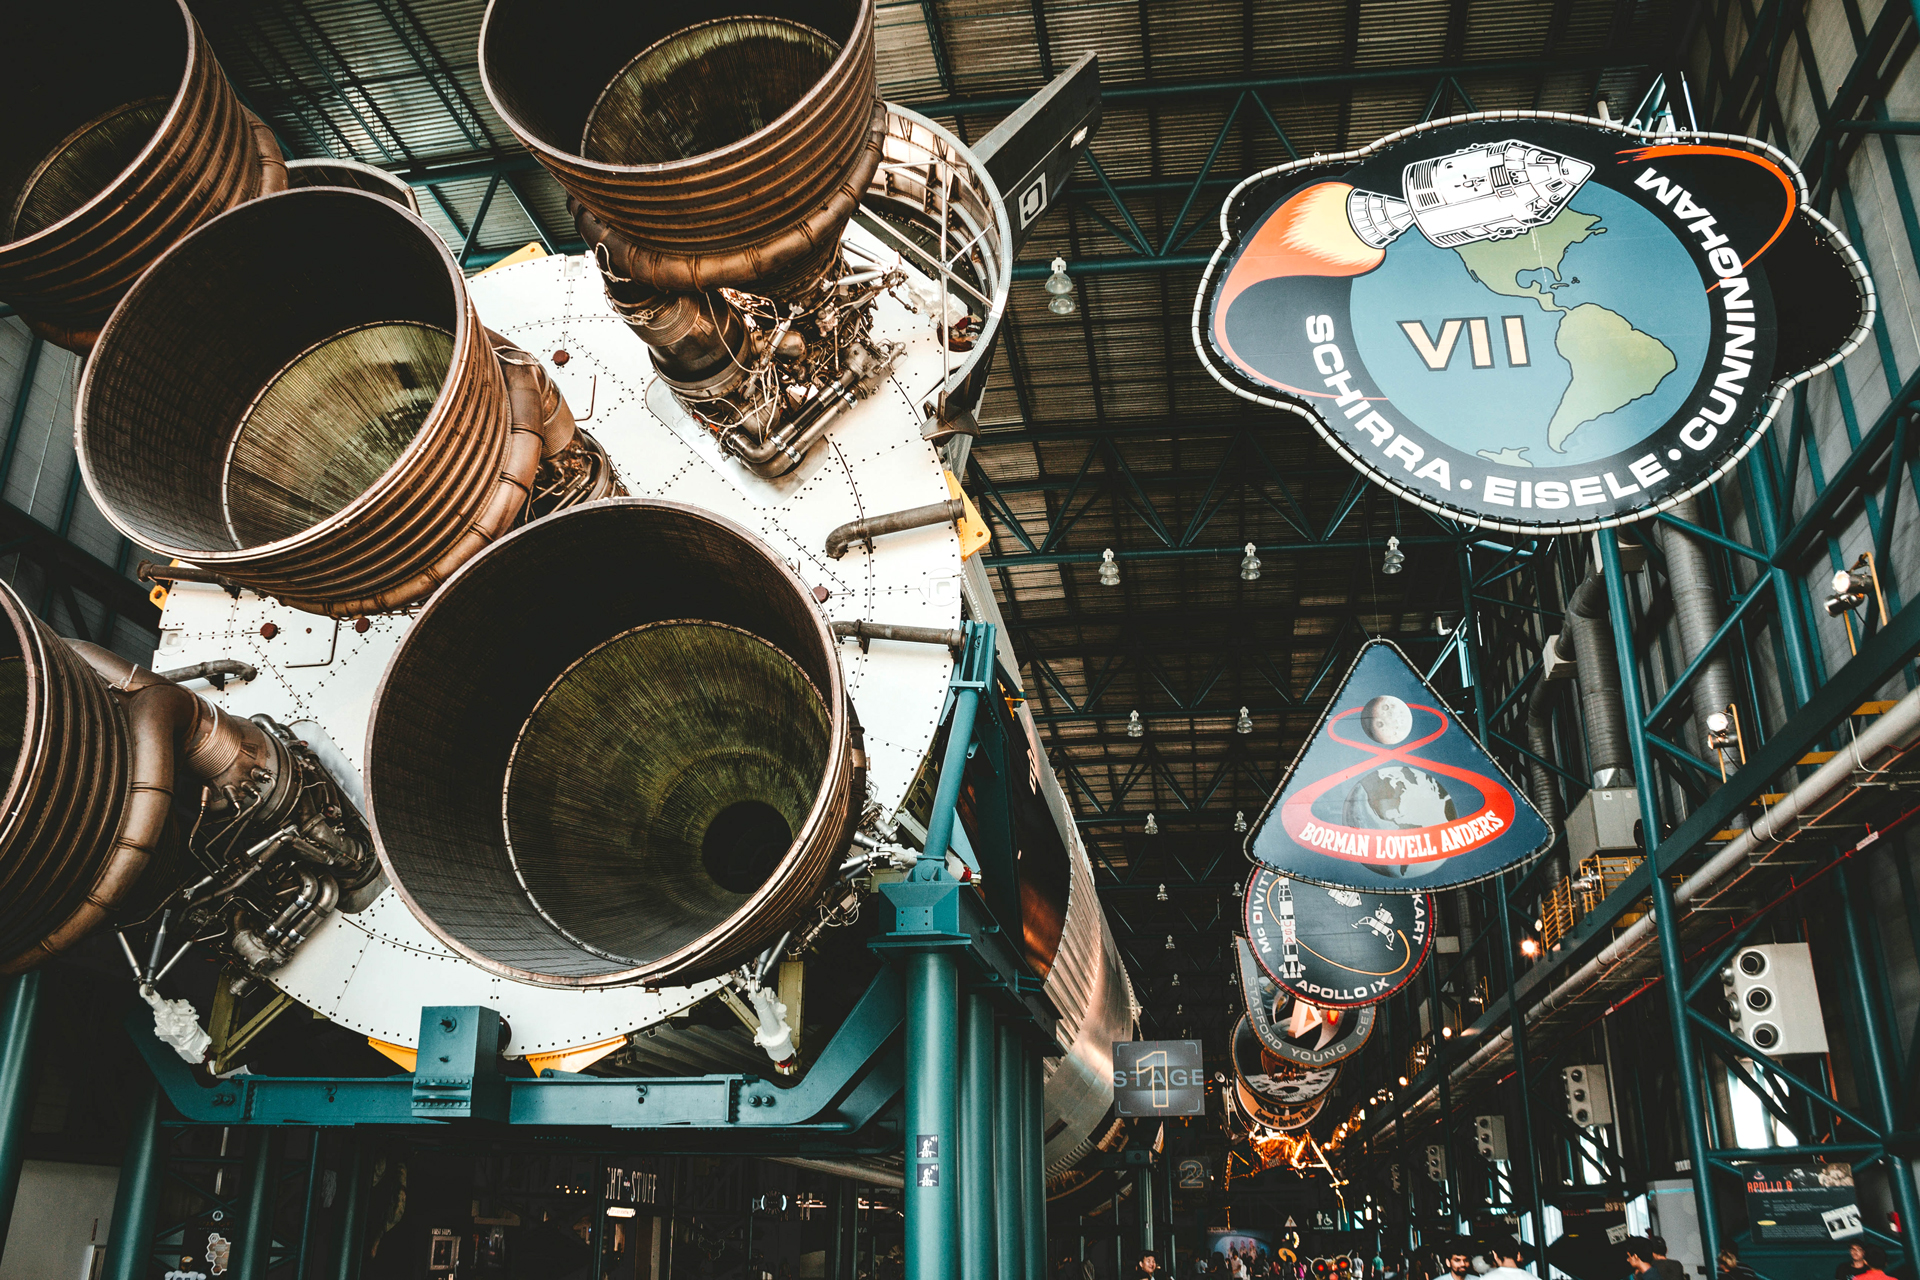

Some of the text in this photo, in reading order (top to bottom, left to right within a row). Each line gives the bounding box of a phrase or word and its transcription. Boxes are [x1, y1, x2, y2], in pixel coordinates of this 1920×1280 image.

[1306, 167, 1756, 510] SCHIRRA EISELE CUNNINGHAM
[1397, 315, 1532, 371] VII
[1298, 810, 1505, 859] BORMAN LOVELL ANDERS
[1283, 920, 1295, 944] USA
[1296, 977, 1390, 1000] APOLLO IX
[1247, 976, 1283, 1050] STAFFORD
[1291, 1043, 1347, 1063] YOUNG
[1113, 1068, 1204, 1088] STAGE
[630, 1170, 658, 1205] STUFF
[1746, 1180, 1784, 1194] APOLLO
